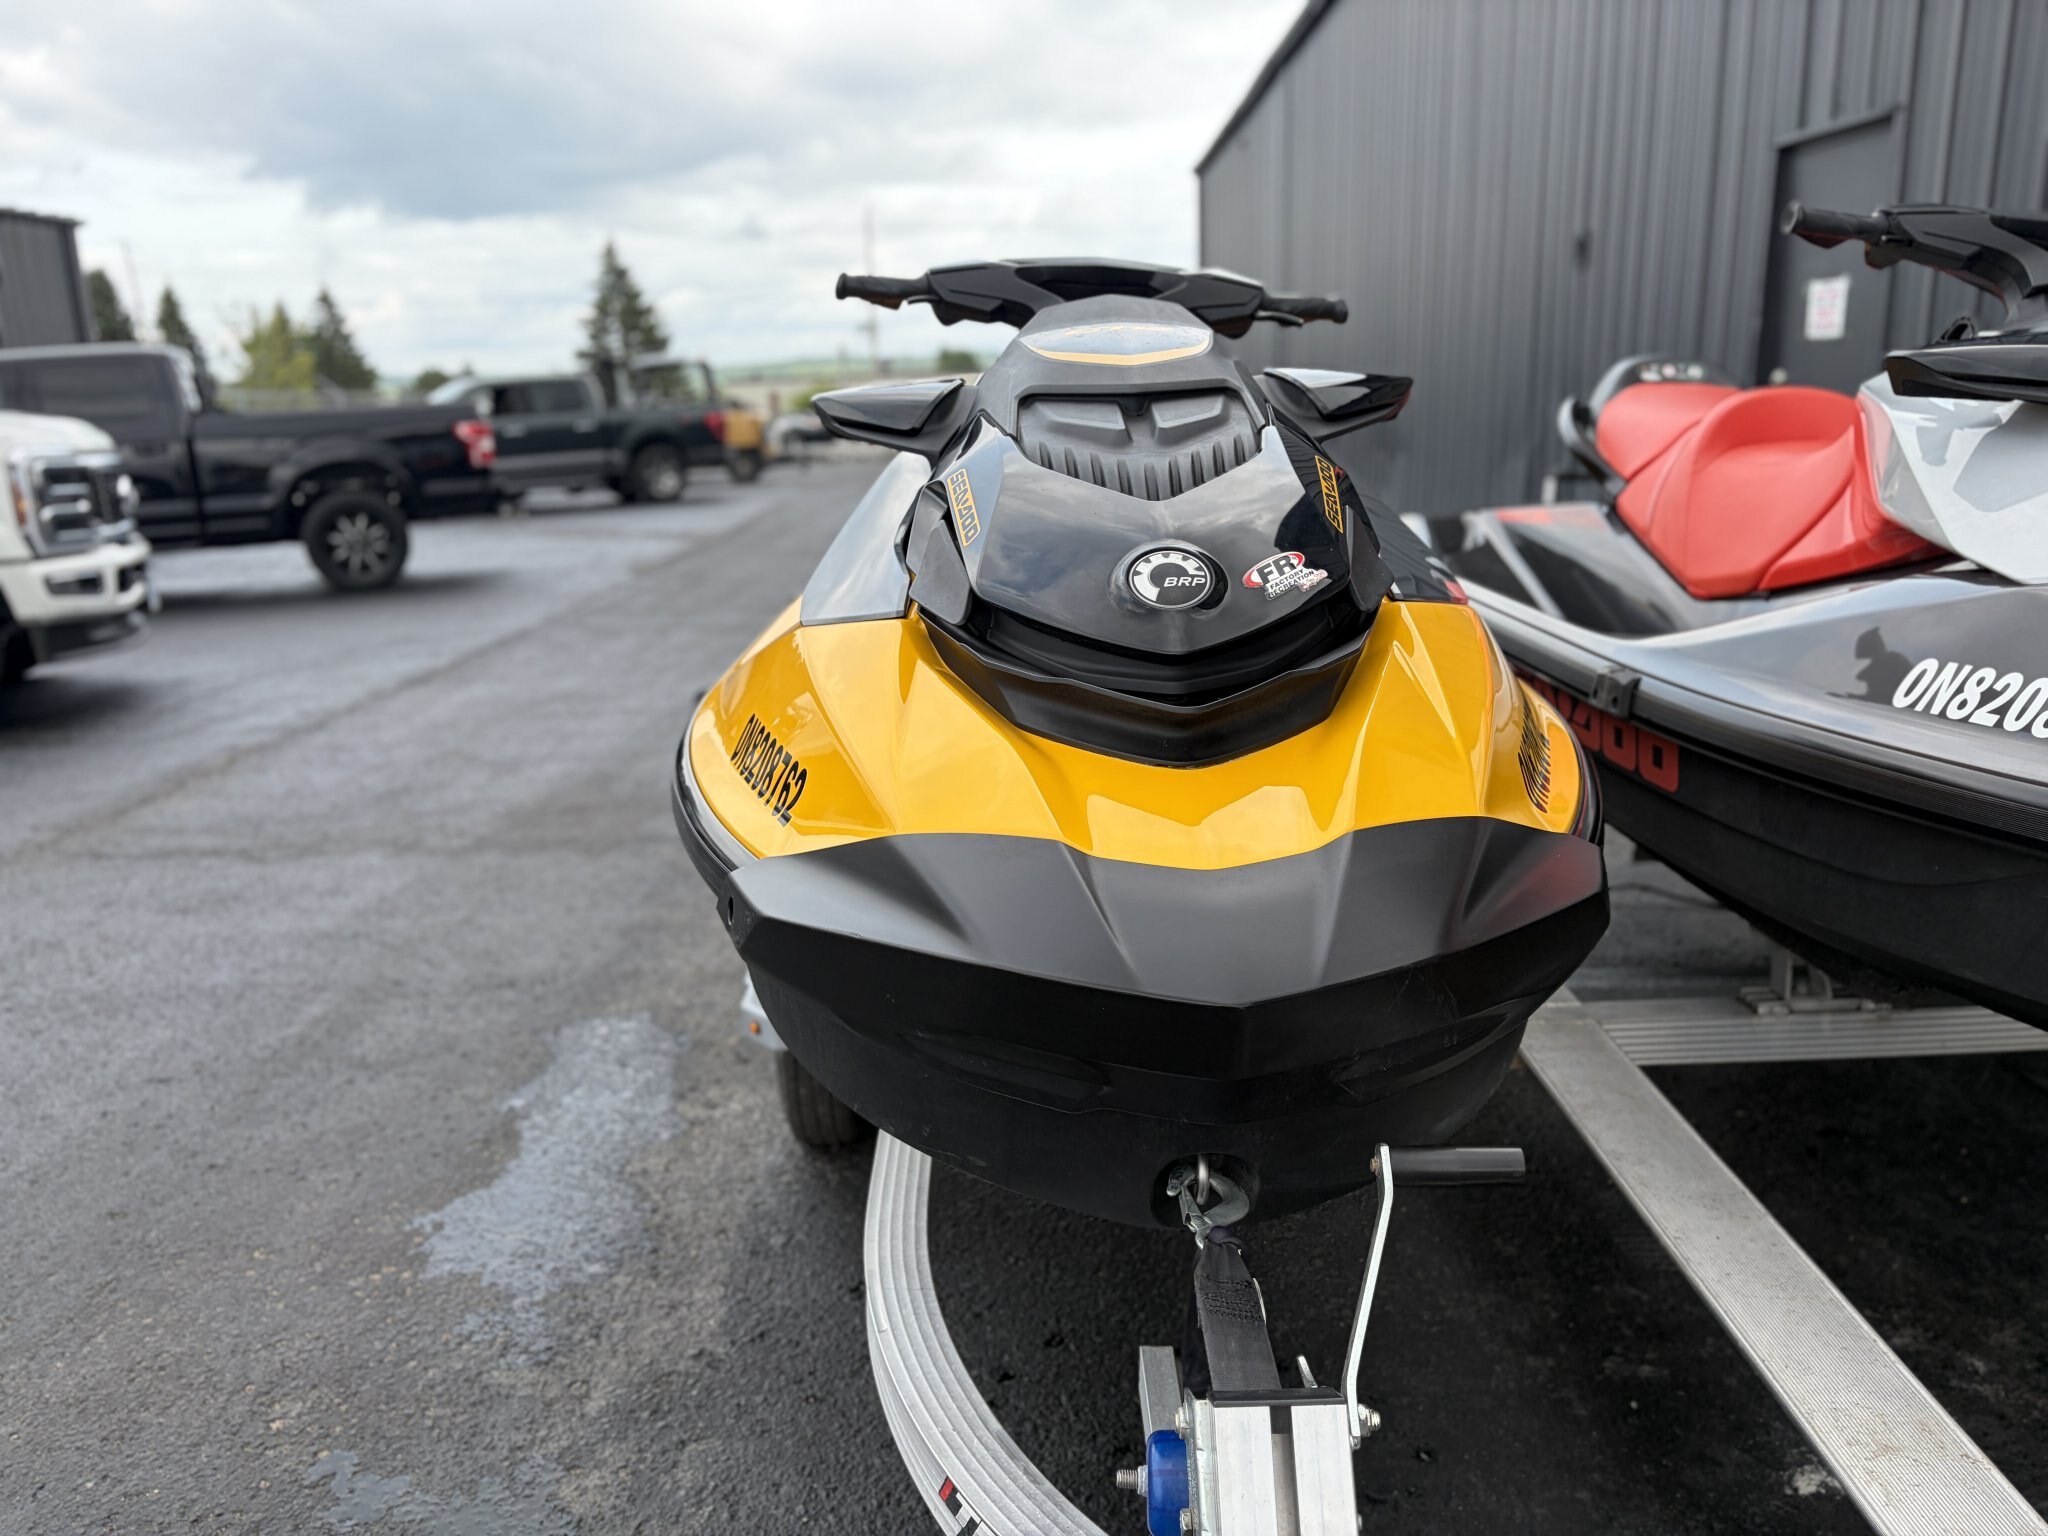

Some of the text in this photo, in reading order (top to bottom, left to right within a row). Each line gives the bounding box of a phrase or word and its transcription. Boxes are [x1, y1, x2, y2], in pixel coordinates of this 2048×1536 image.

[1163, 576, 1206, 587] BRP
[1256, 555, 1297, 584] FR
[1270, 568, 1304, 590] FACTORY
[1268, 570, 1314, 598] RECREATION
[730, 713, 808, 828] ON8208762
